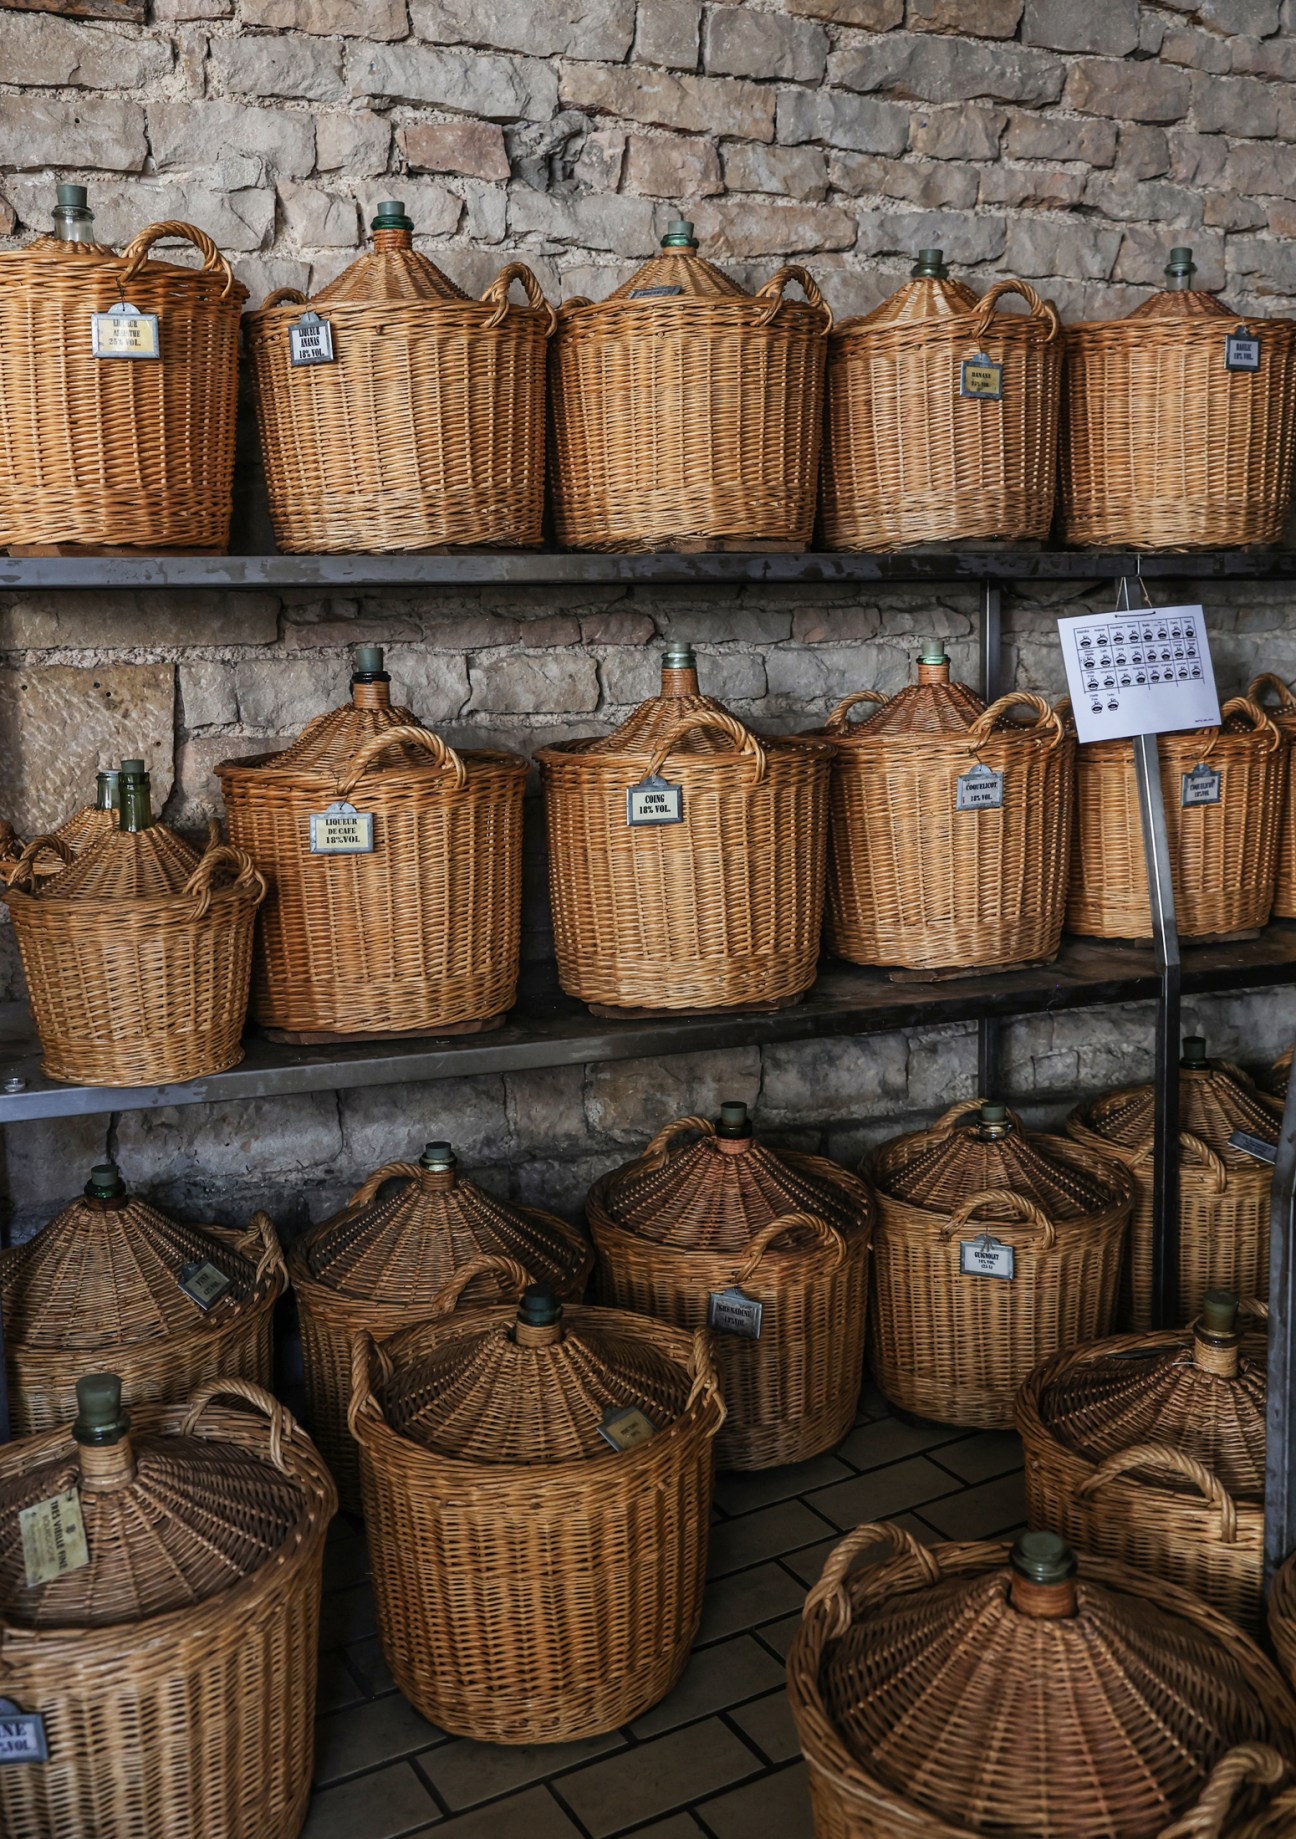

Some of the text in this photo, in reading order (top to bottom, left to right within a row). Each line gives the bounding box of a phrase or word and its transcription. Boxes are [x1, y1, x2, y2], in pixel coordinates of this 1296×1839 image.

[298, 326, 320, 337] LIQUEUR
[300, 336, 320, 347] ANANAS
[299, 348, 324, 359] 18% VOL.
[966, 781, 997, 791] COQUELICOT
[645, 794, 665, 804] COING
[639, 804, 671, 814] 18% VOL.
[50, 1500, 69, 1570] TRES VIEILLE FINE
